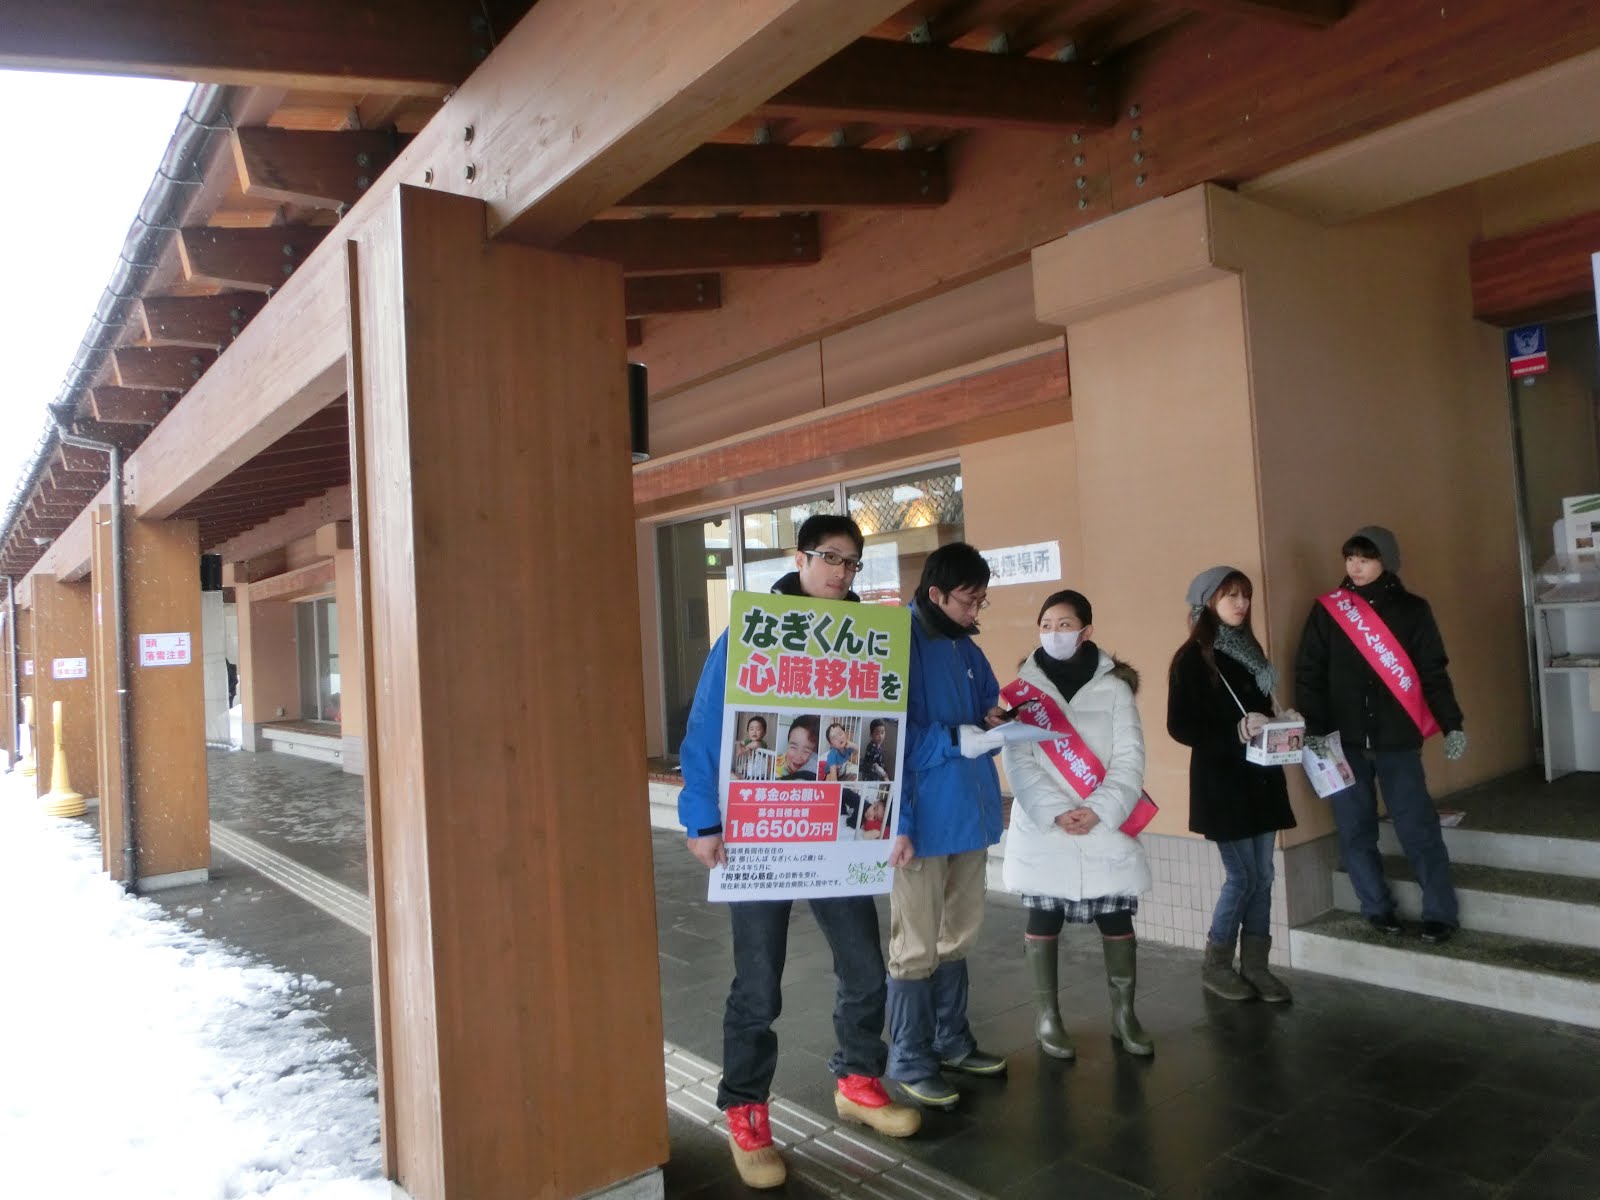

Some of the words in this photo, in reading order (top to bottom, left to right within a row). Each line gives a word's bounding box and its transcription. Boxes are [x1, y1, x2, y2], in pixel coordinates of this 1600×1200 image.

[741, 607, 889, 656] なぎくんに
[145, 649, 187, 661] 落雪注意
[738, 652, 902, 701] 心臓移植を
[755, 787, 825, 802] 募金のお願い
[757, 807, 810, 818] 募金目標金額
[730, 819, 834, 838] 1億6500万円
[722, 863, 772, 872] 成24年5月に
